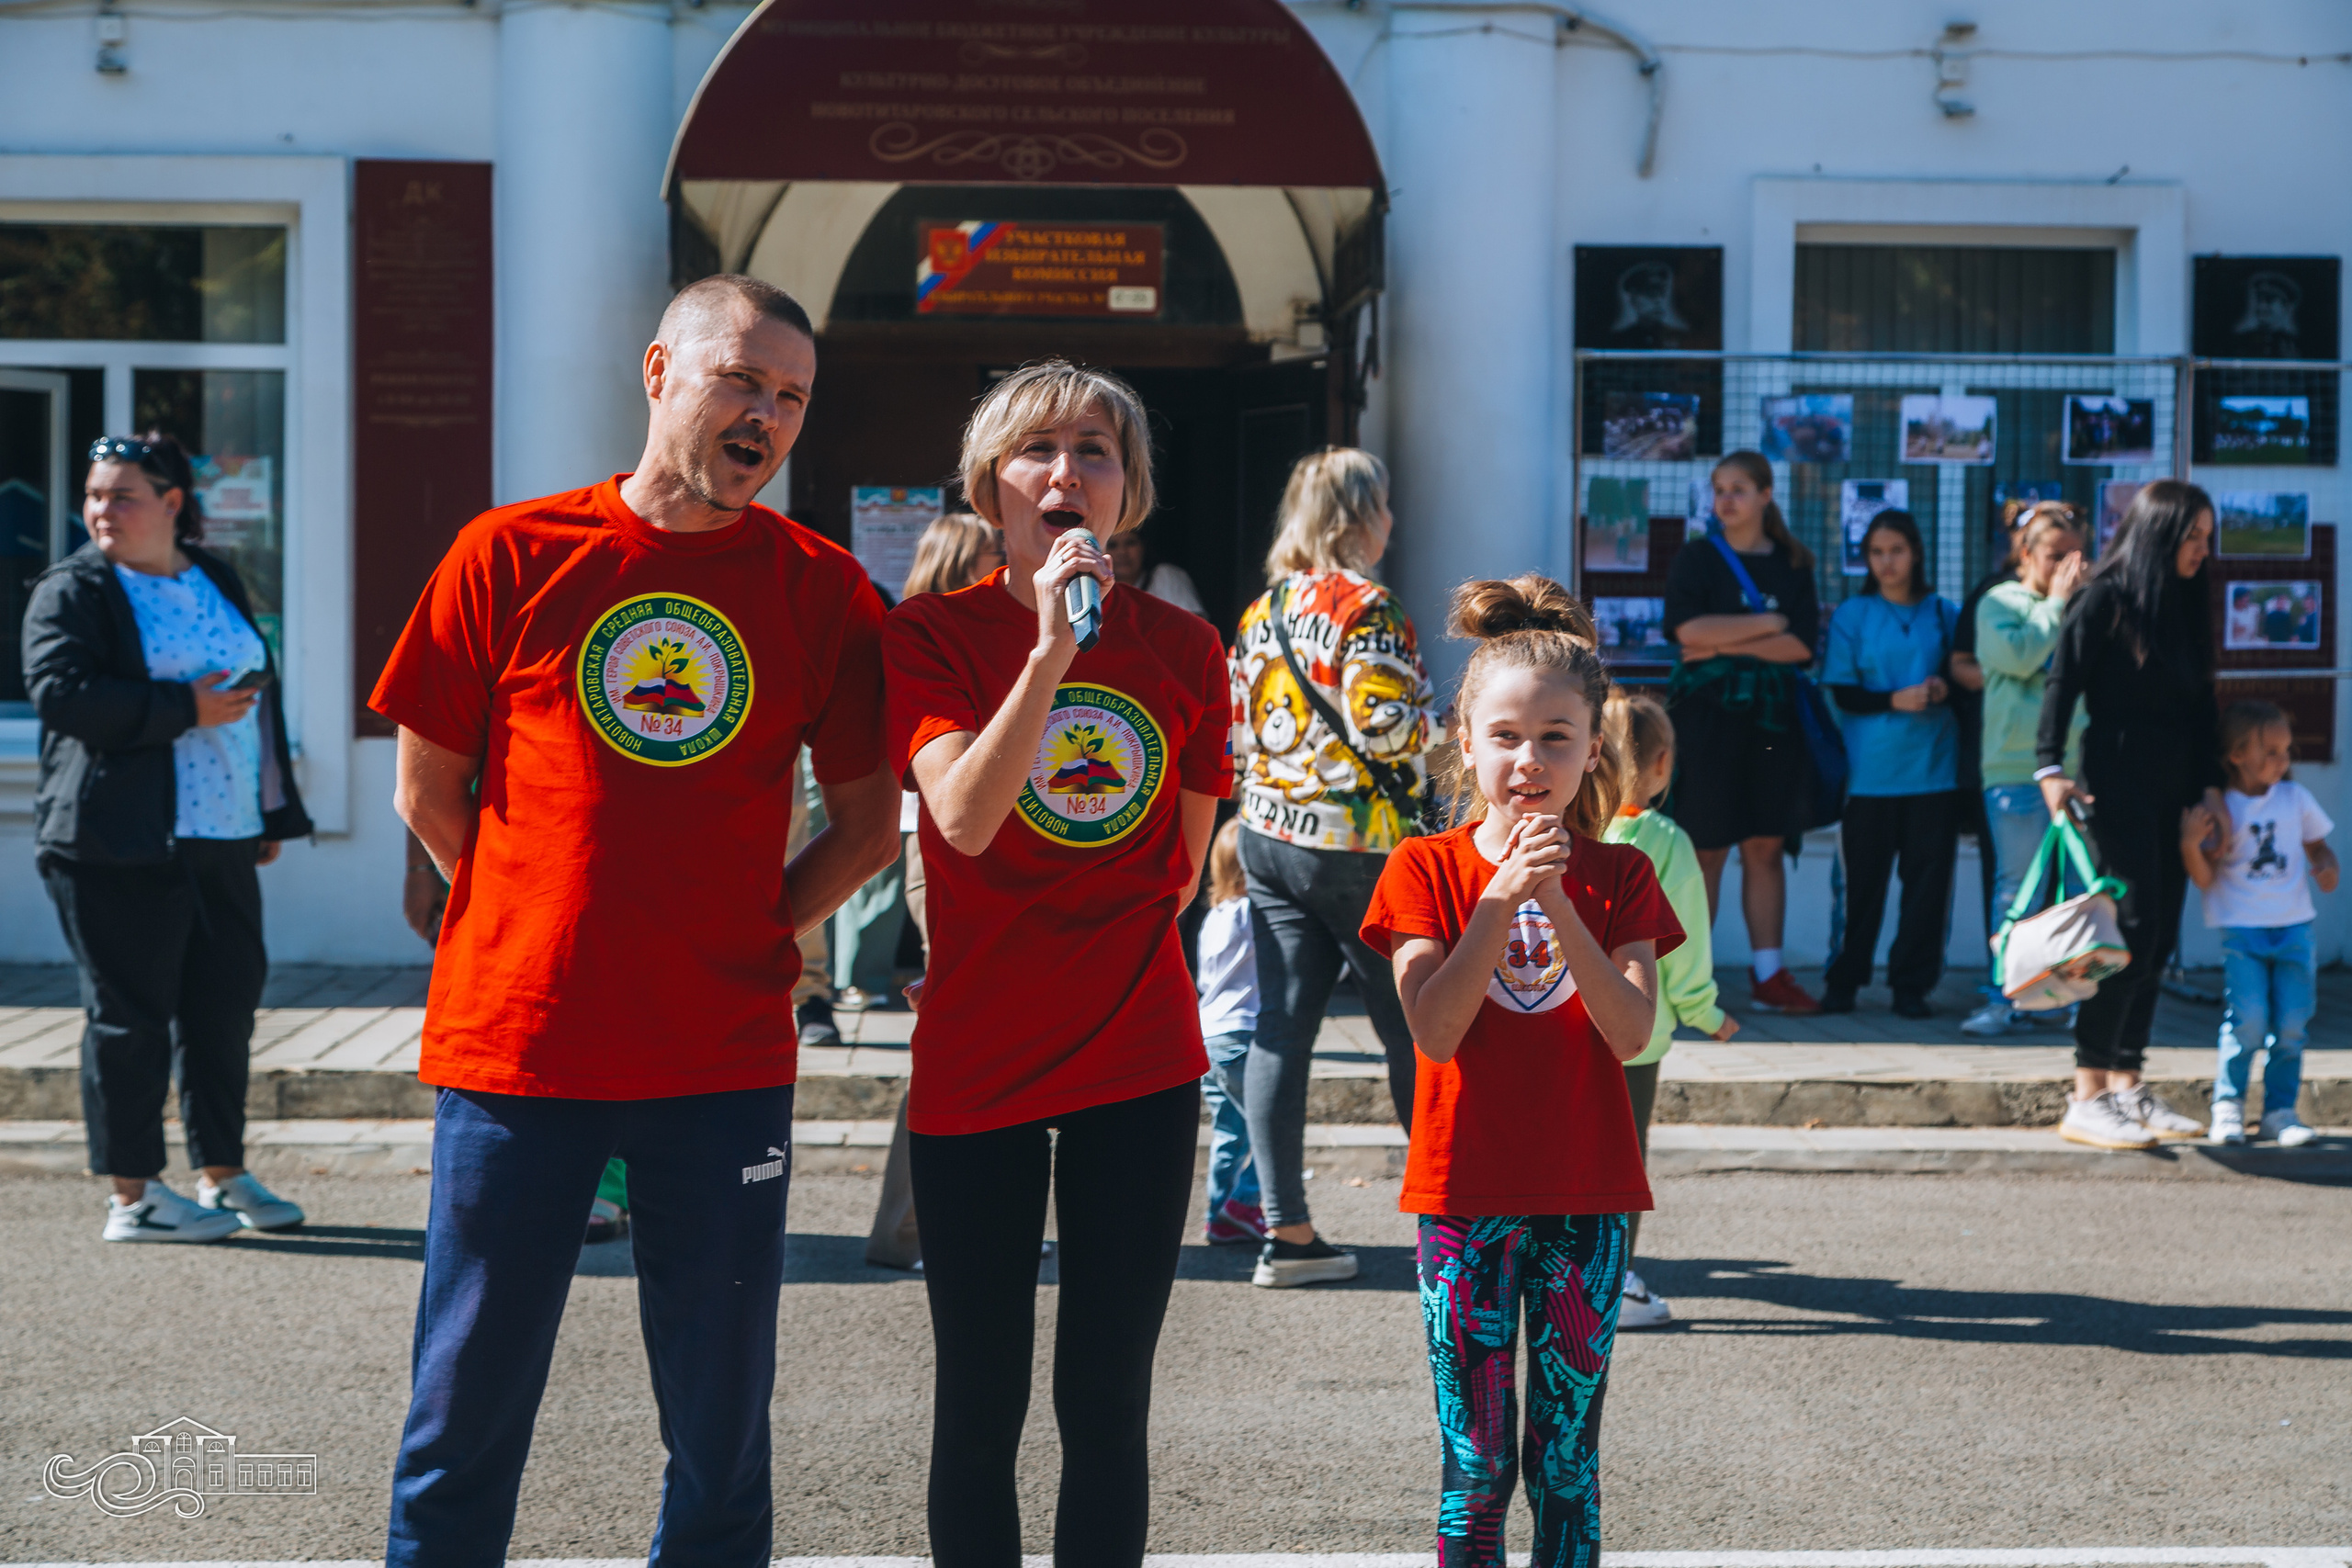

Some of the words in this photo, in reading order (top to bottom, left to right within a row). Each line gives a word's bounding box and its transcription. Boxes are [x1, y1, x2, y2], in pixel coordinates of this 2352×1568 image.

[601, 602, 654, 638] СРЕДНЯЯ
[606, 655, 620, 683] ГЕРОЯ
[613, 621, 662, 655] СОВЕТСКОГО
[665, 620, 696, 639] СОЮЗА
[705, 652, 727, 715] ПОКРЫШКИНА
[665, 601, 746, 724] ОБЩЕОБРАЗОВАТЕЛЬНАЯ
[586, 644, 643, 751] НОВОТИТАРОВСКАЯ
[678, 728, 723, 756] ШКОЛА
[1068, 690, 1160, 796] ОБЩЕОБРАЗОВАТЕЛЬНАЯ
[1073, 708, 1104, 721] СОЮЗА
[1121, 728, 1143, 789] ПОКРЫШКИНА
[1102, 802, 1142, 835] ШКОЛА
[1508, 939, 1552, 969] 34
[742, 1159, 784, 1185] PUMA
